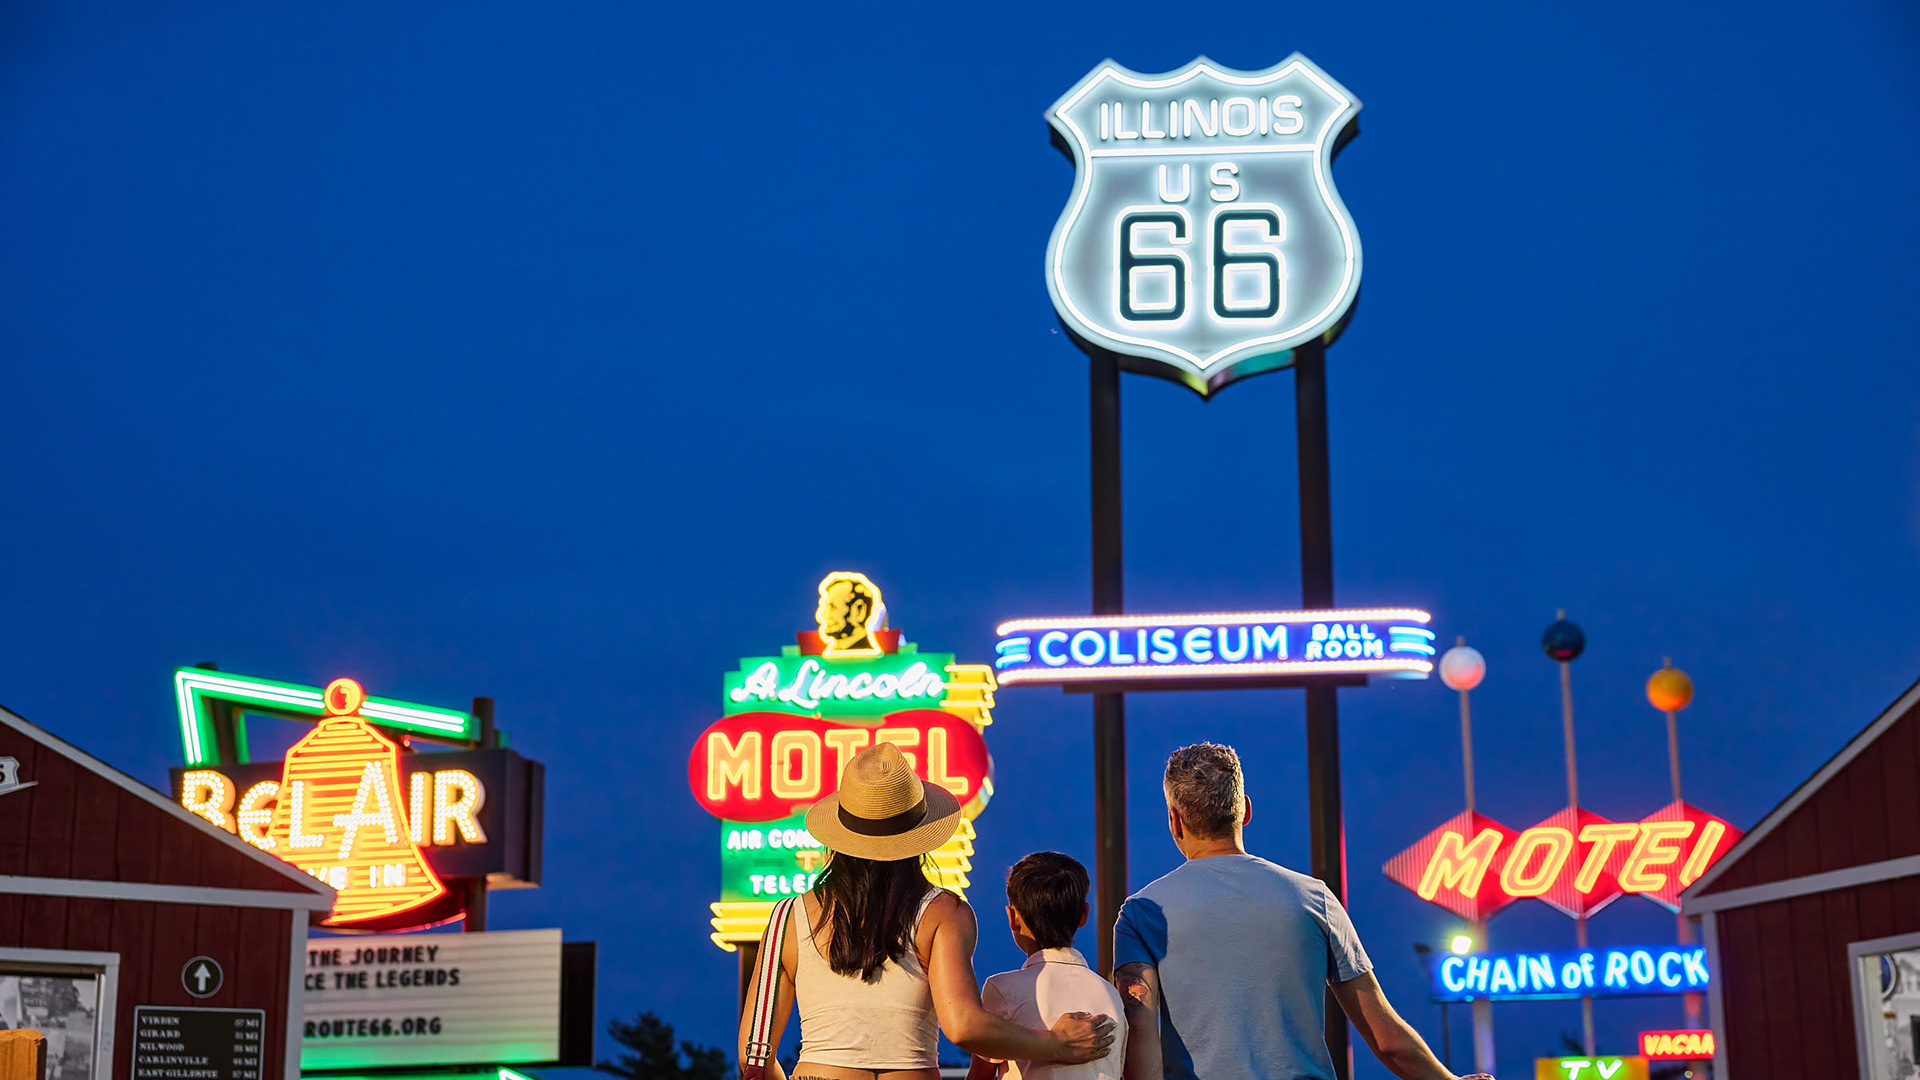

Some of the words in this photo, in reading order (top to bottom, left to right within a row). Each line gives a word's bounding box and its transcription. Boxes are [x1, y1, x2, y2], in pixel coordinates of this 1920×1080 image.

[1100, 95, 1304, 140] ILLINOIS
[1113, 204, 1287, 328] 66
[1311, 623, 1378, 641] BALL
[1037, 625, 1289, 666] COLISEUM
[1305, 638, 1385, 660] ROOM
[778, 659, 944, 709] Lincoln
[726, 829, 762, 850] AIR
[369, 863, 403, 888] IN
[310, 950, 341, 966] THE
[350, 946, 439, 965] JOURNEY
[334, 972, 367, 989] THE
[376, 969, 460, 988] LEGENDS
[1441, 954, 1556, 993] CHAIN
[1560, 953, 1595, 989] of
[139, 1029, 181, 1039] GIRARD
[139, 1042, 185, 1052] NILWOOD
[138, 1055, 209, 1066] CARLINVILLE
